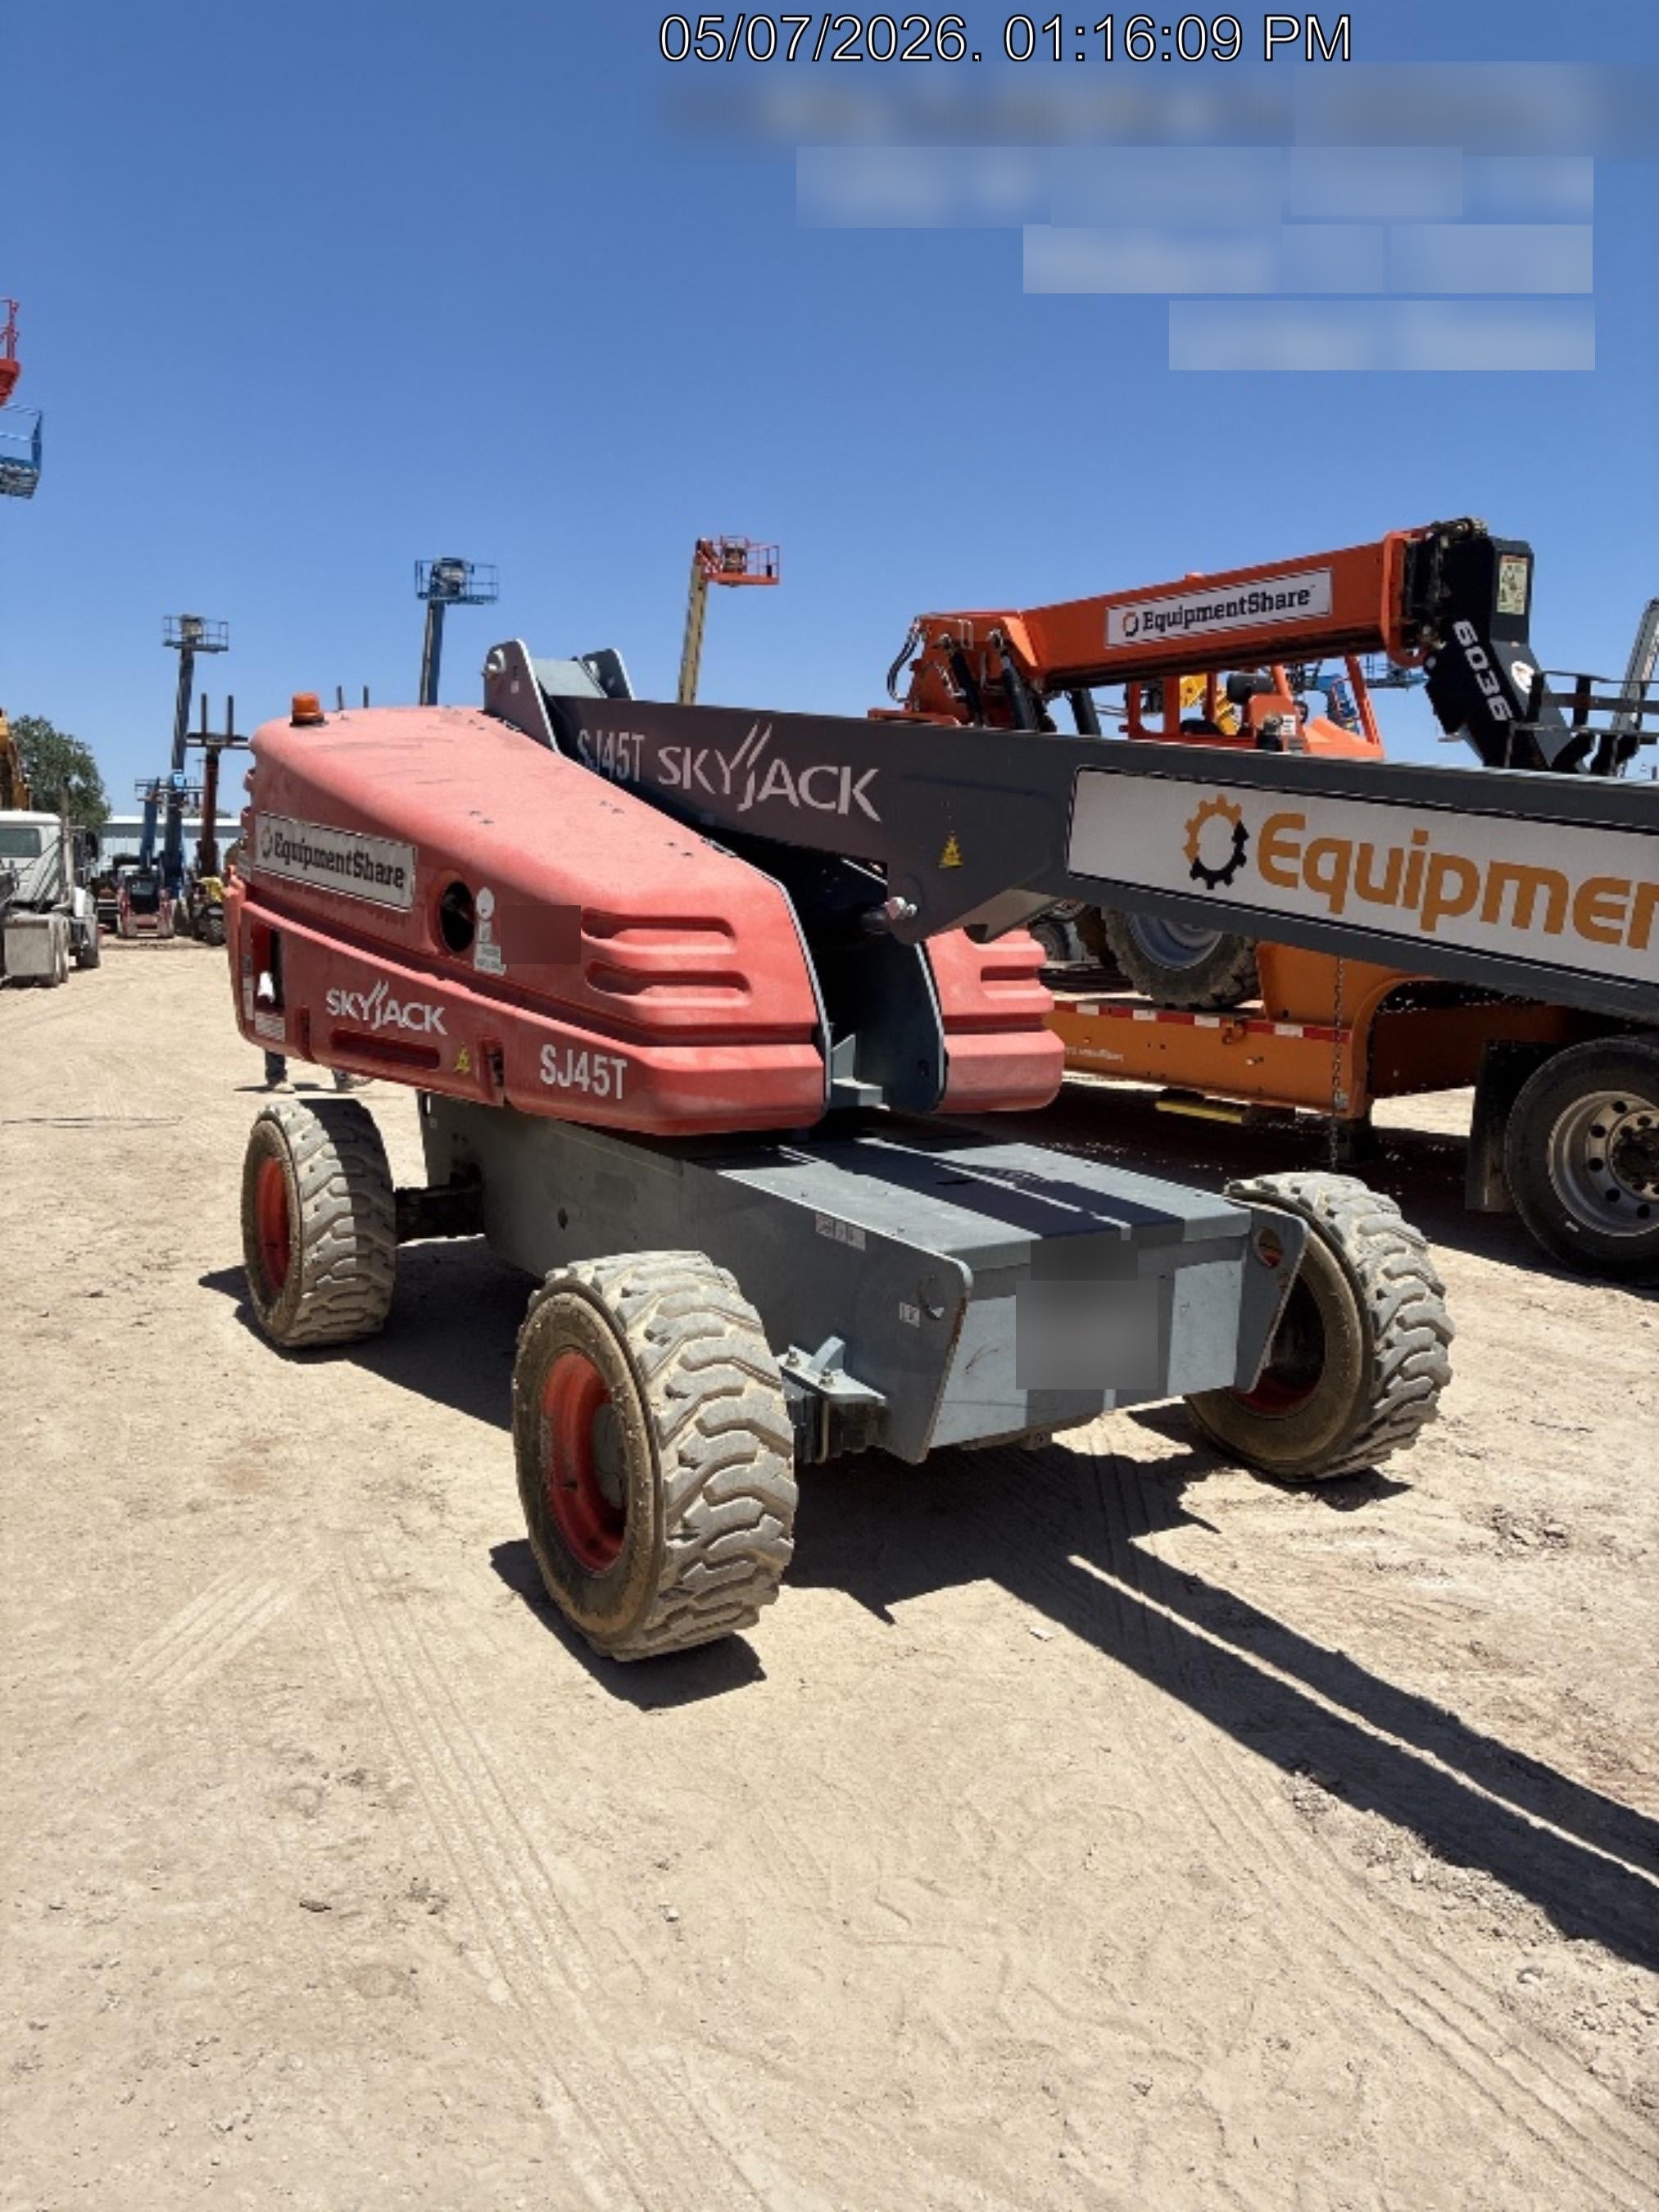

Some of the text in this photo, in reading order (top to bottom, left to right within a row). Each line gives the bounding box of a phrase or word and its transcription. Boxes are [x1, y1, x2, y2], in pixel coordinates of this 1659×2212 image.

[1142, 588, 1311, 632] EquipmentShare
[1452, 619, 1514, 722] 6036
[576, 717, 882, 823] SJ45T SKYJACK
[274, 831, 406, 889] EquipmentShare
[325, 979, 448, 1036] SKYJACK
[539, 1043, 628, 1100] SJ45T
